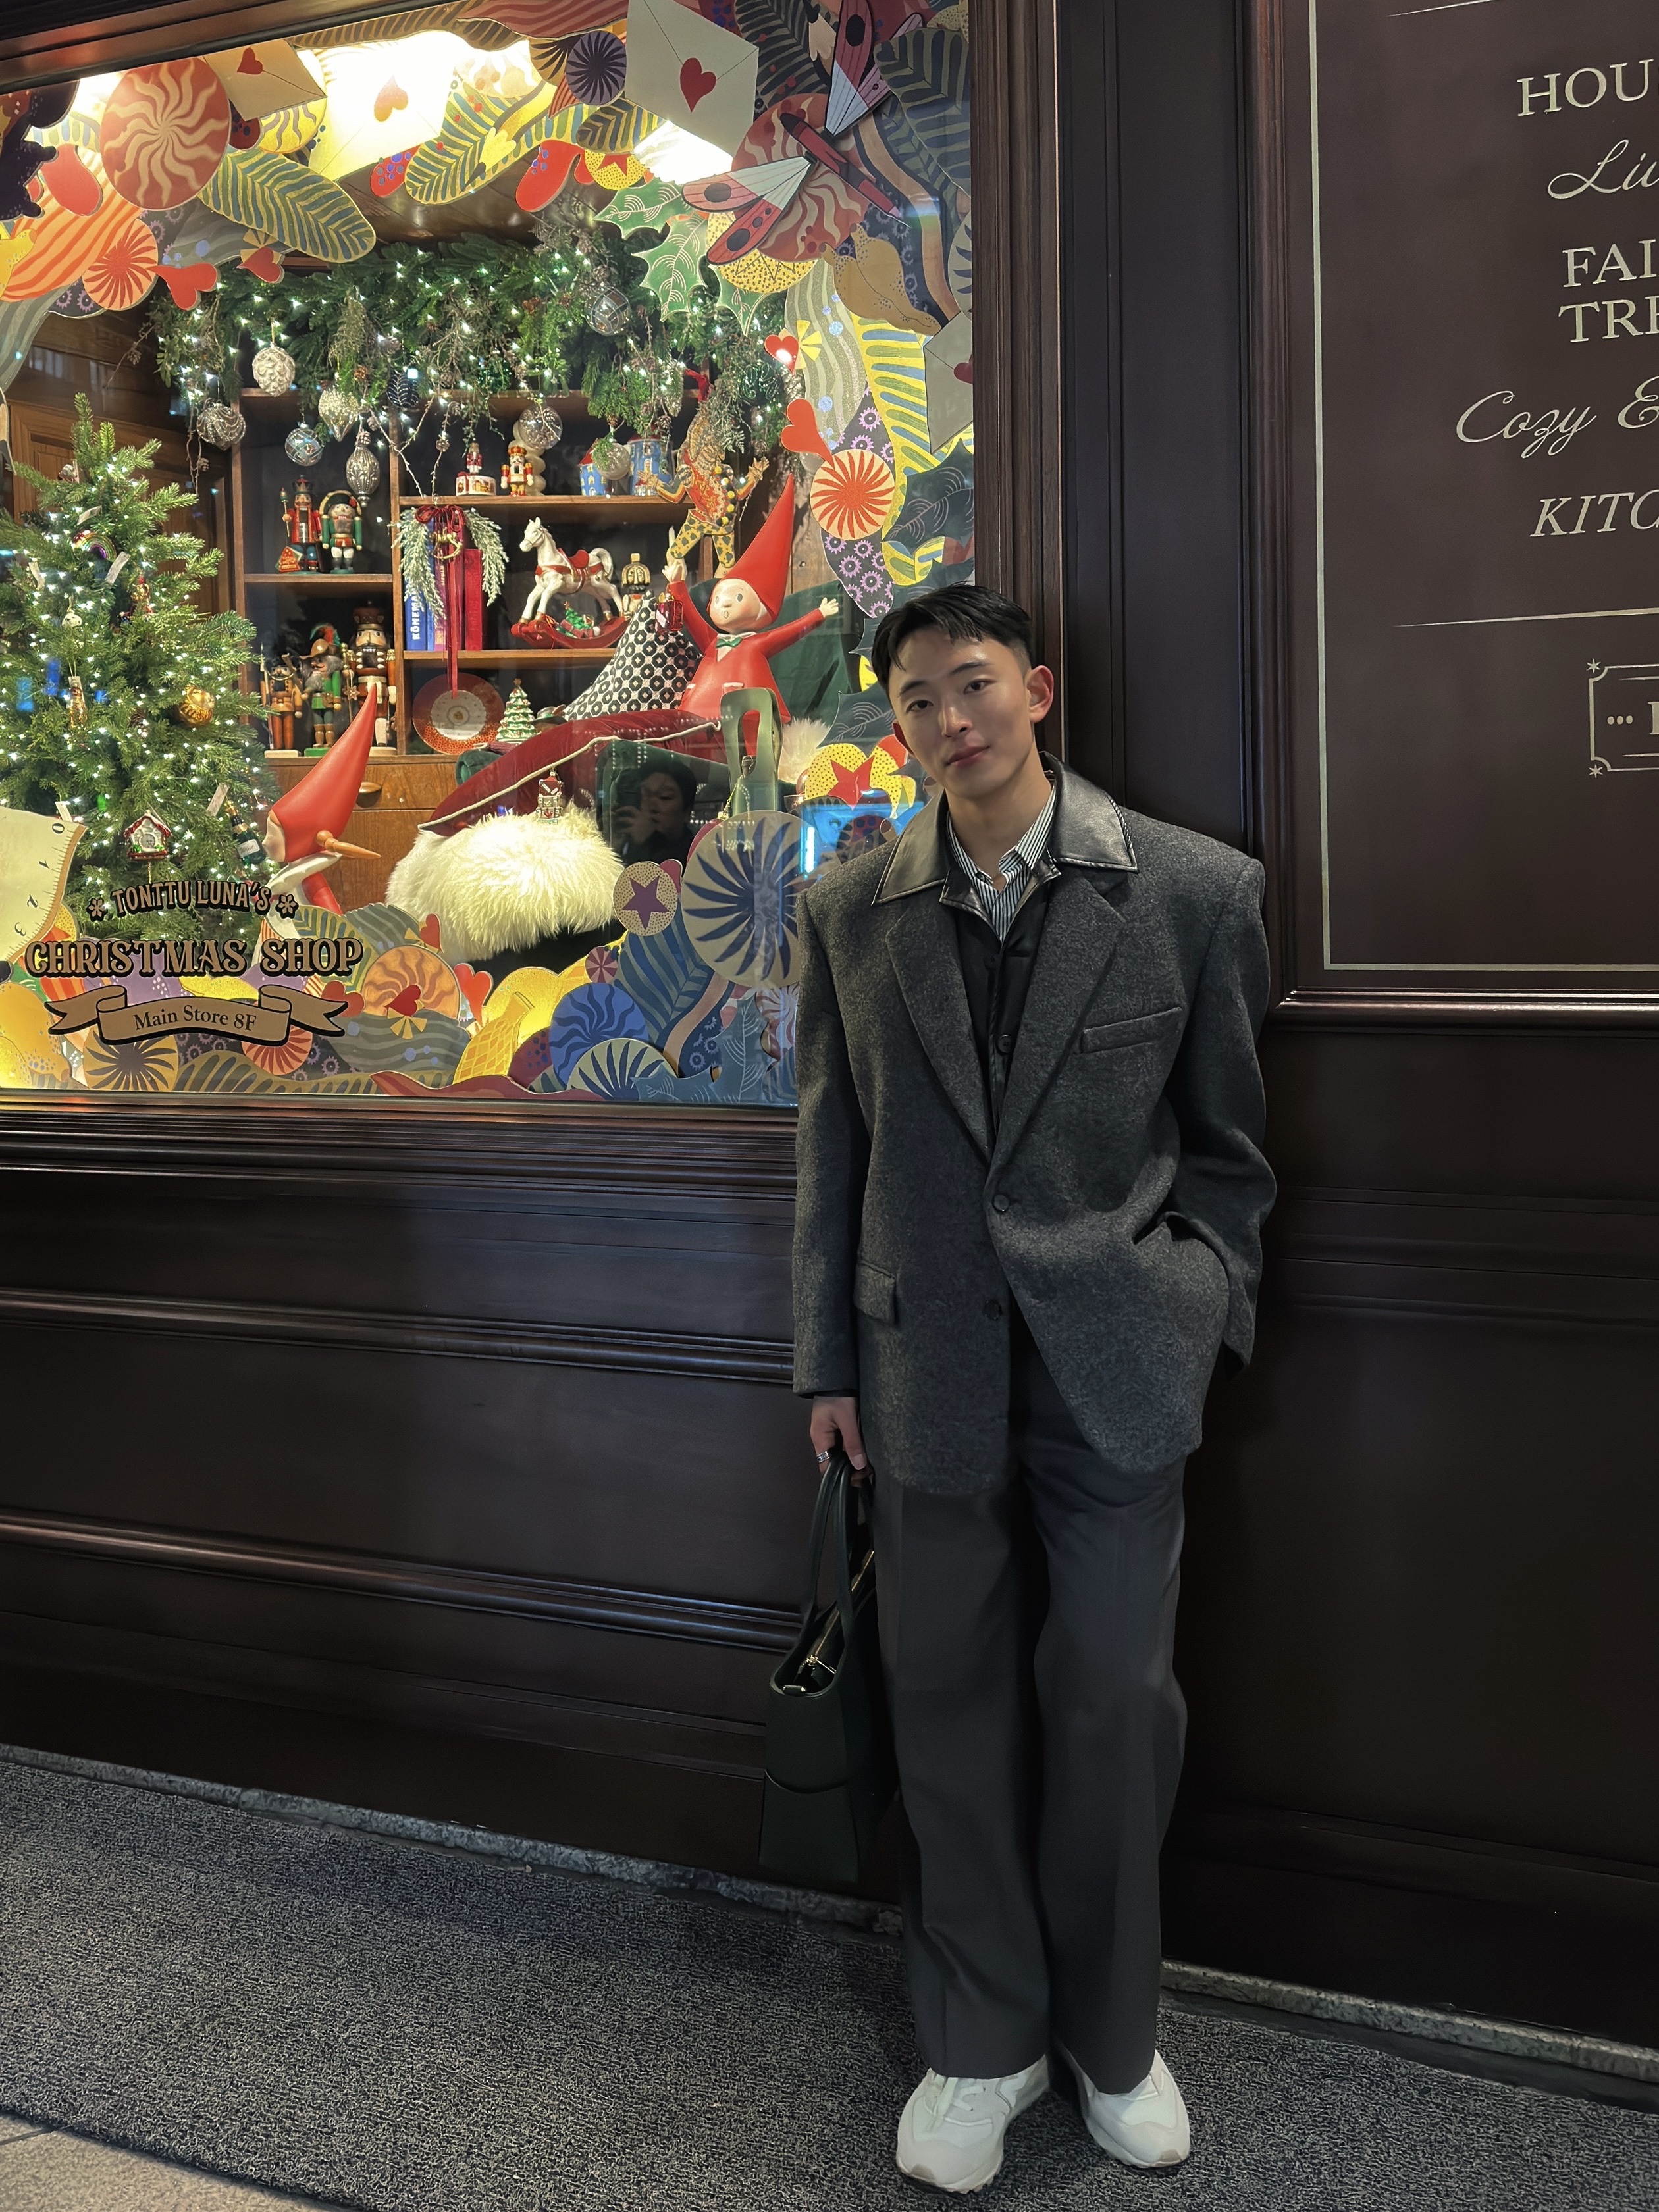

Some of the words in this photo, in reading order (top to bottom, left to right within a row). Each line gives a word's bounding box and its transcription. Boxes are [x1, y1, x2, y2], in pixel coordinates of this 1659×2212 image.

[1517, 58, 1654, 116] HOU
[1562, 238, 1657, 288] FAI
[1456, 390, 1597, 459] Cozy
[111, 881, 191, 917] TONTTU
[196, 880, 272, 915] LUNA'S
[24, 939, 248, 977] CHRISTMAS
[260, 938, 363, 977] SHOP
[133, 1008, 179, 1030] Main
[183, 1004, 228, 1025] Store
[234, 1013, 257, 1031] 8F
